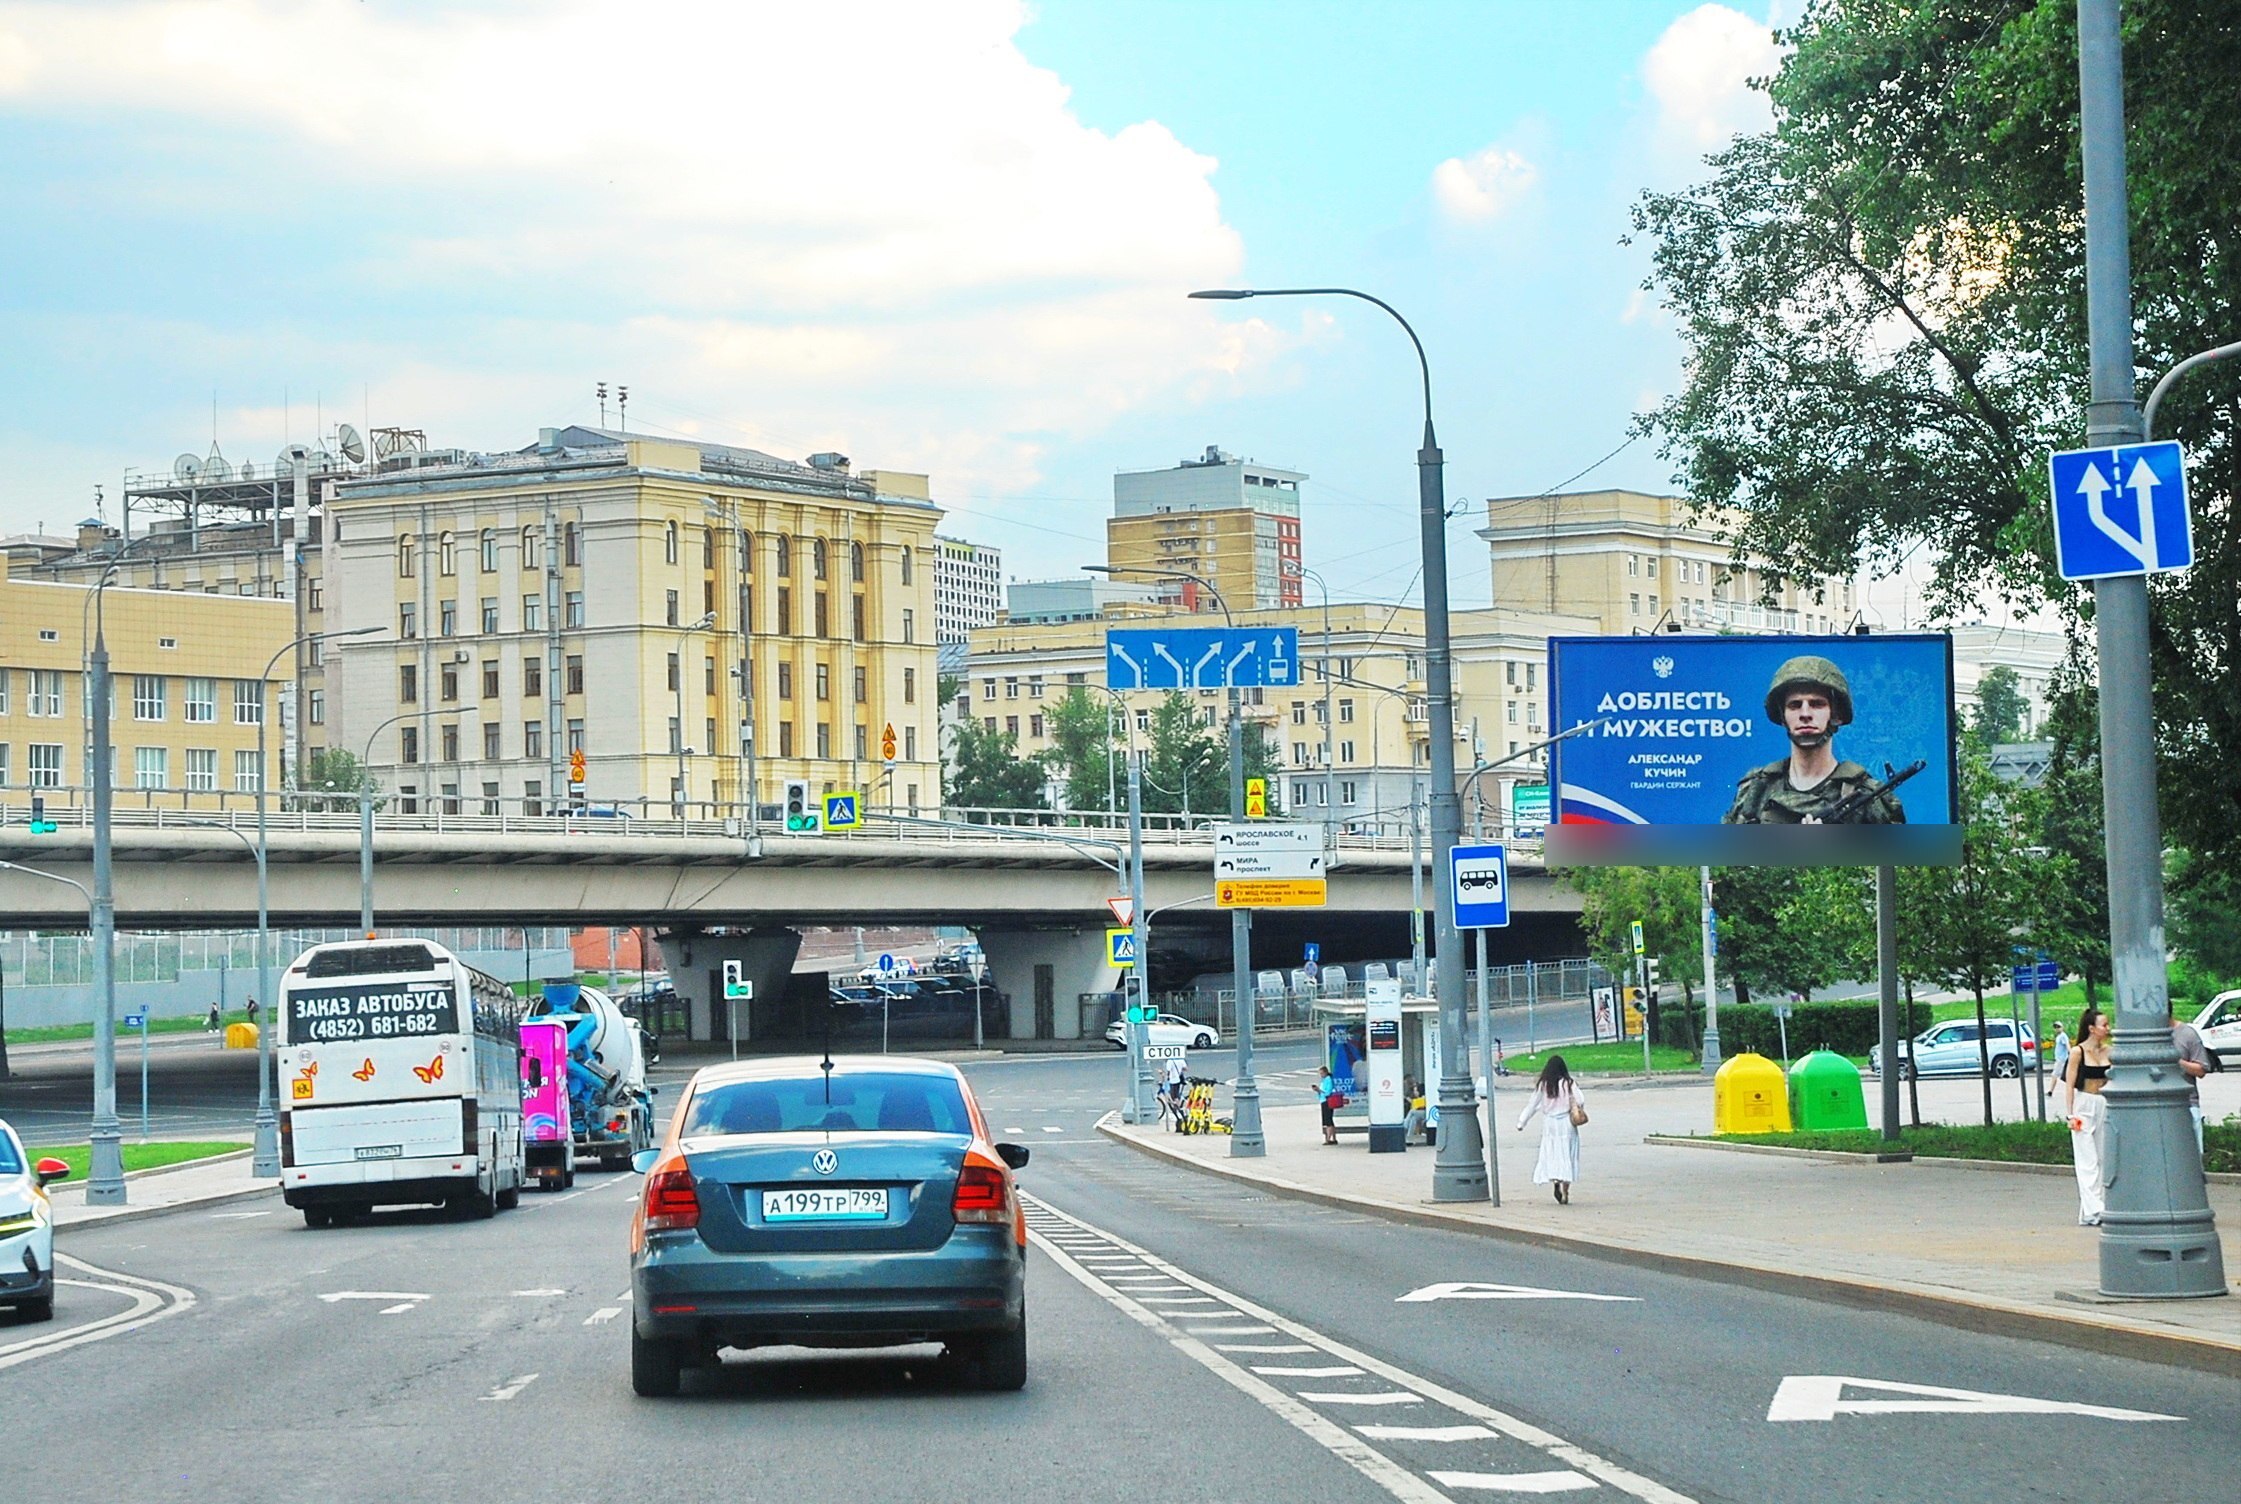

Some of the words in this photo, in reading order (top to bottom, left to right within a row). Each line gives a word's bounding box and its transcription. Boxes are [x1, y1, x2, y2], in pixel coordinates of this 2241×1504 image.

[1597, 691, 1731, 712] ДОБЛЕСТЬ
[1602, 718, 1752, 738] МУЖЕСТВО!
[1628, 754, 1703, 765] АЛЕКСАНДР
[1644, 768, 1686, 778] КУЧИН
[1630, 781, 1664, 790] ГВАРДИИ
[1665, 781, 1701, 789] СЕРЖАНТ
[1236, 830, 1294, 838] ЯРОСЛАВСКОЕ
[296, 997, 351, 1019] ЗАКАЗ
[357, 991, 449, 1014] АВТОБУСА
[309, 1018, 365, 1040] (4852)
[371, 1013, 437, 1034] 681-682
[1148, 1047, 1181, 1058] СТОП
